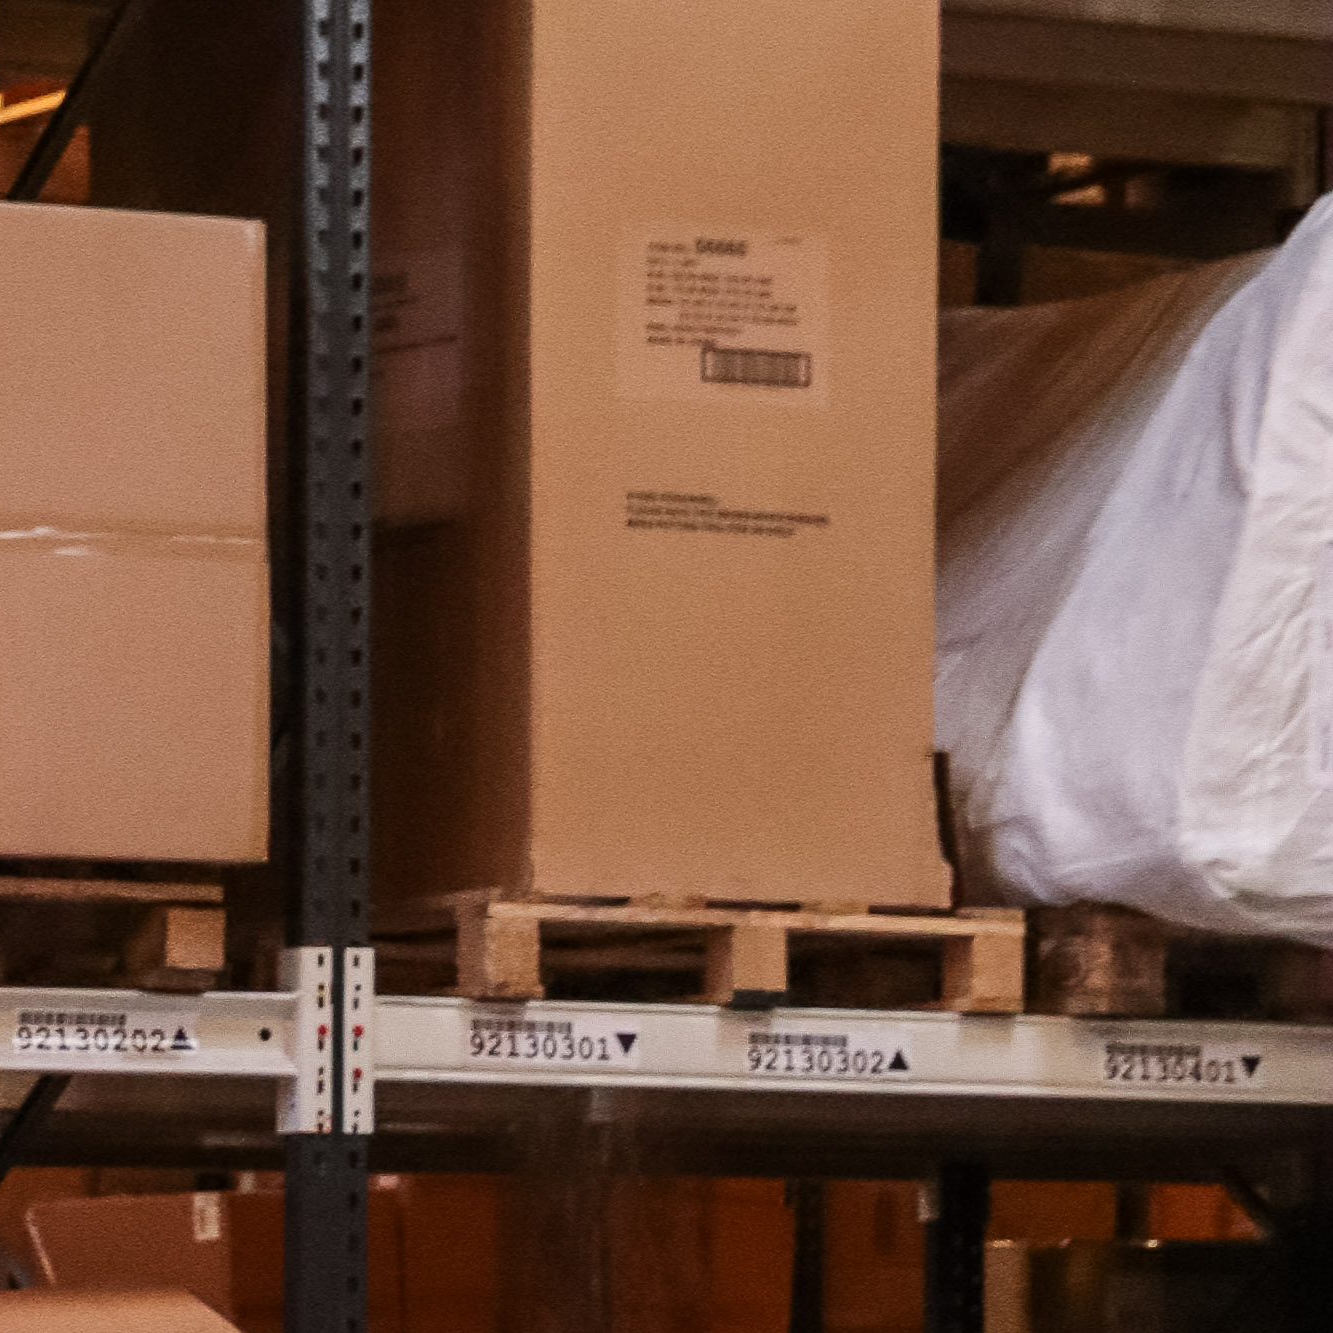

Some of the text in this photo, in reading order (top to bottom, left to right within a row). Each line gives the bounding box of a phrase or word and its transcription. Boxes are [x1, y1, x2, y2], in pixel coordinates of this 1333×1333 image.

[17, 1028, 165, 1052] 92130202
[470, 1032, 610, 1061] 92130301
[747, 1047, 884, 1075] 92130302
